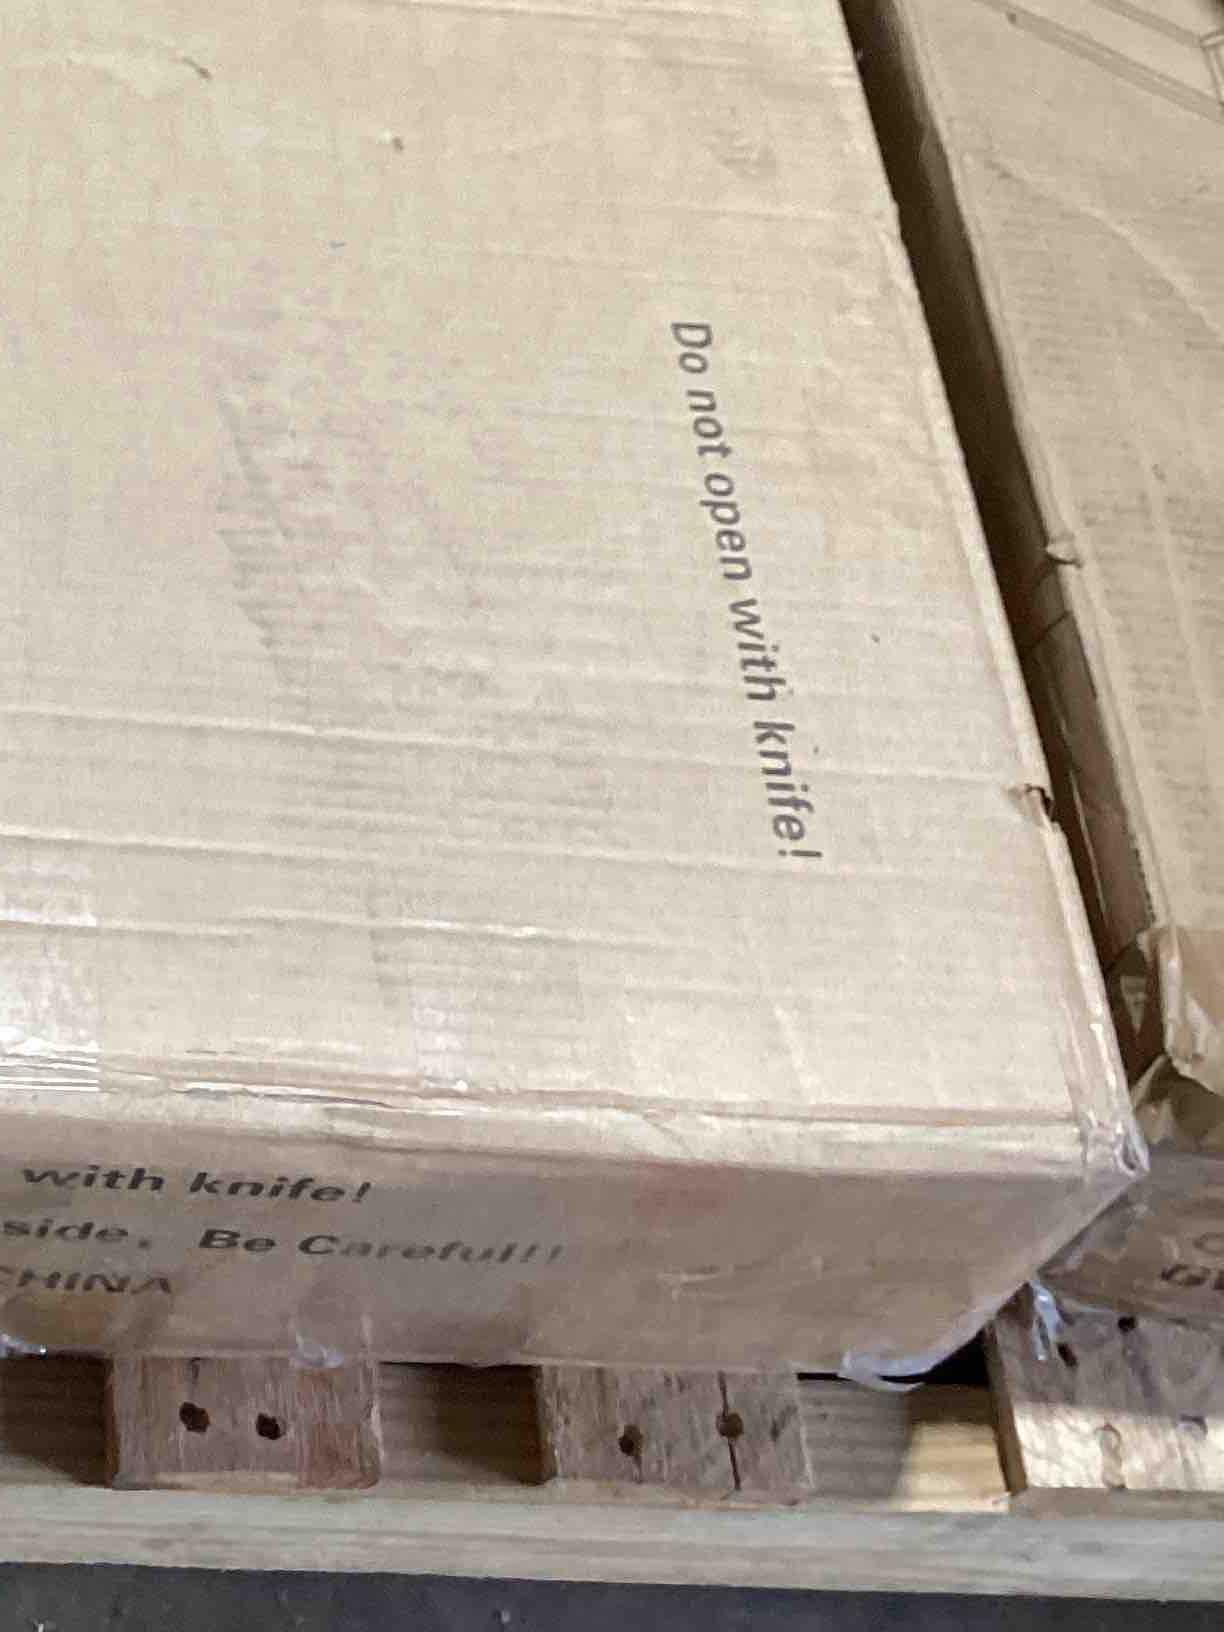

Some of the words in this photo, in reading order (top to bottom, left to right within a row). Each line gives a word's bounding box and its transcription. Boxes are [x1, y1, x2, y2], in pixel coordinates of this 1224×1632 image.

[671, 321, 714, 374] Do
[686, 389, 734, 459] not
[699, 471, 754, 581] open
[729, 597, 787, 702] with
[753, 719, 824, 858] knife!
[22, 1164, 165, 1194] with
[188, 1170, 373, 1204] knife!
[197, 1228, 277, 1255] Be
